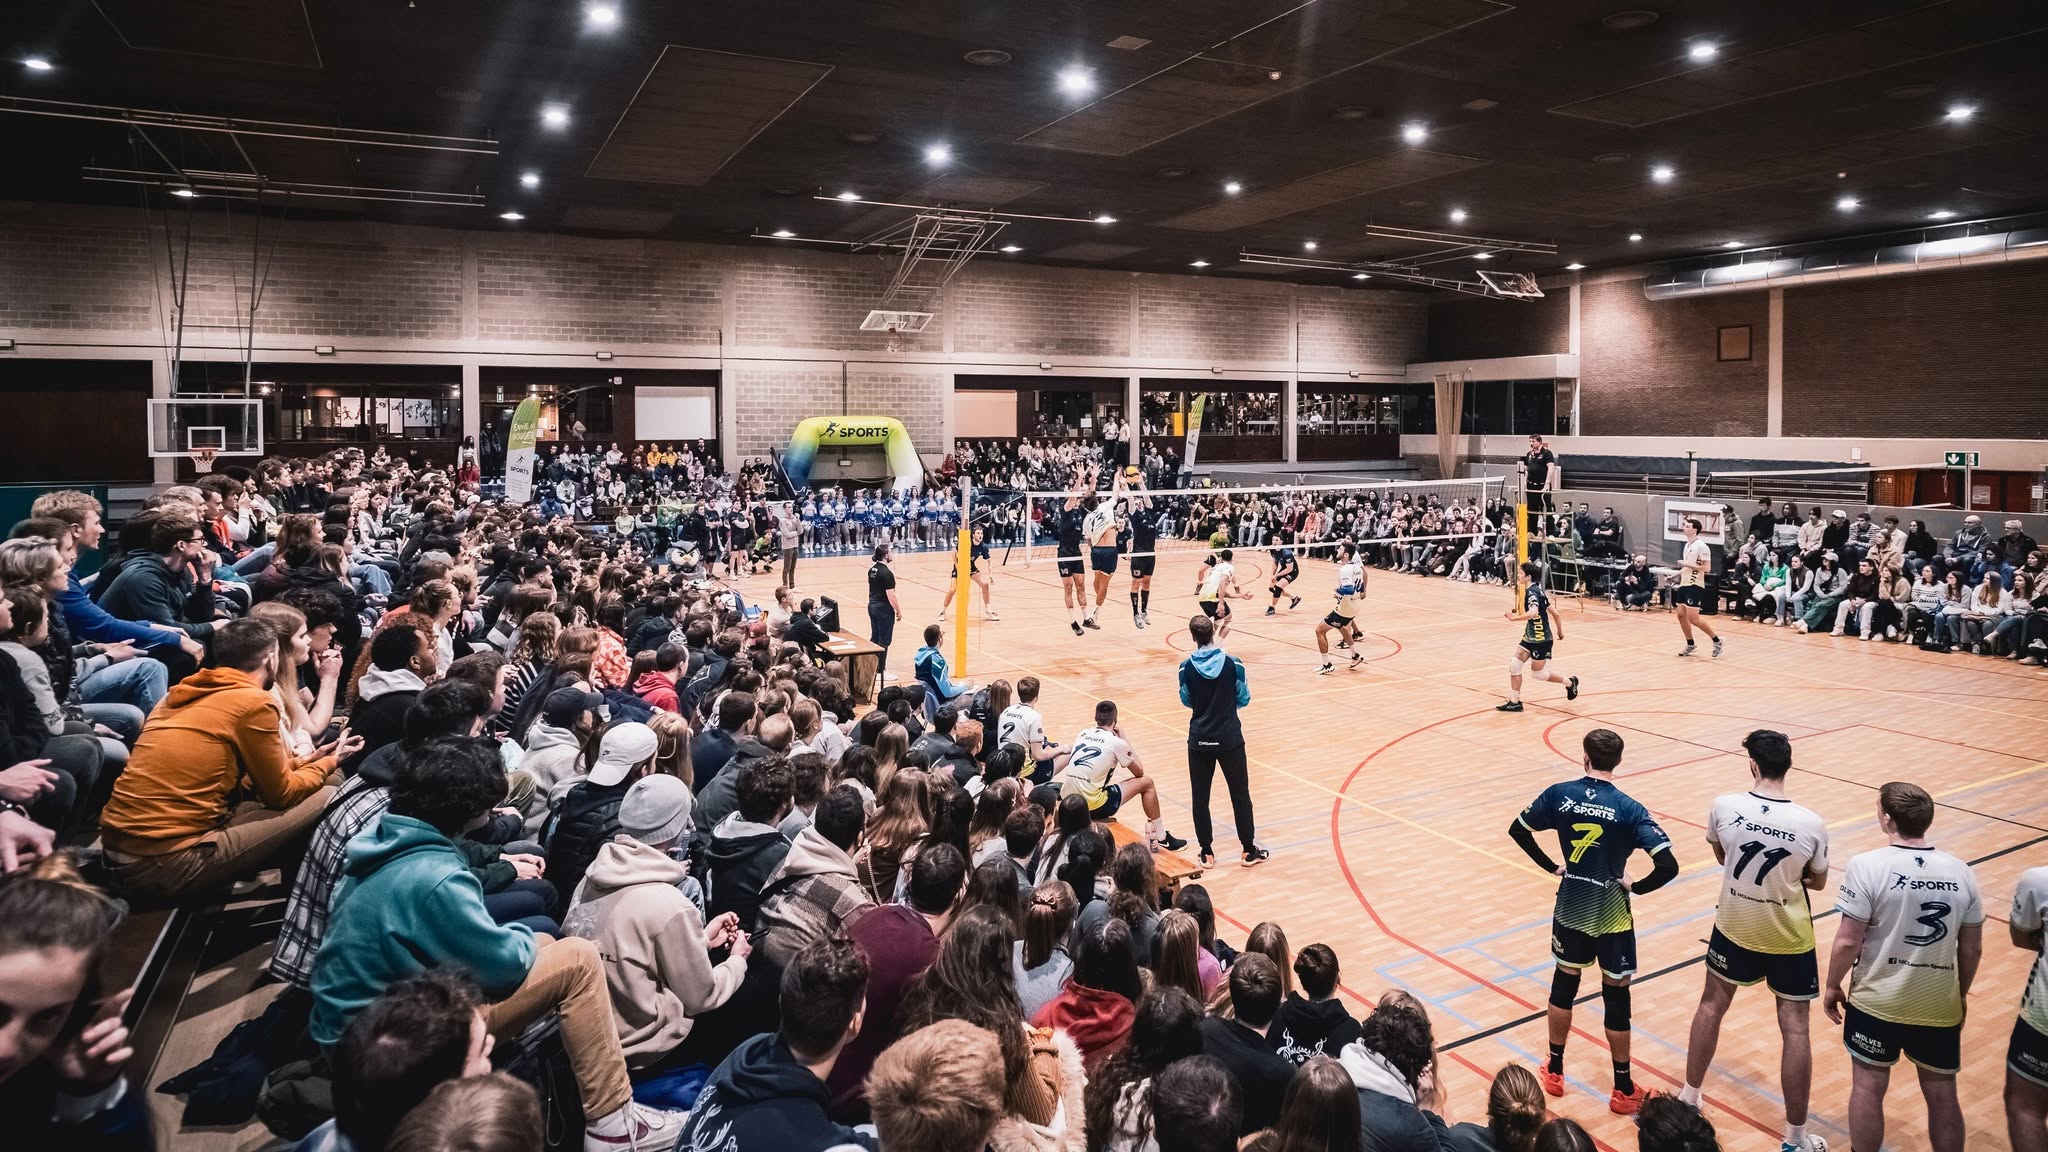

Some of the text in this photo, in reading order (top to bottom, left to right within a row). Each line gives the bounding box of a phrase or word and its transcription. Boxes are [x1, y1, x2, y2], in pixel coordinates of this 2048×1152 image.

[840, 427, 889, 438] SPORTS
[510, 466, 529, 475] SPORTS
[1000, 721, 1016, 743] 2
[1070, 743, 1102, 770] 12
[1573, 805, 1614, 821] SPORTS
[1745, 822, 1796, 842] SPORTS
[1569, 822, 1604, 864] 7
[1733, 840, 1793, 887] 11
[1840, 884, 1856, 899] OLVES
[1910, 880, 1959, 892] SPORTS
[1903, 901, 1951, 947] 3
[1855, 1031, 1882, 1048] WOLVES
